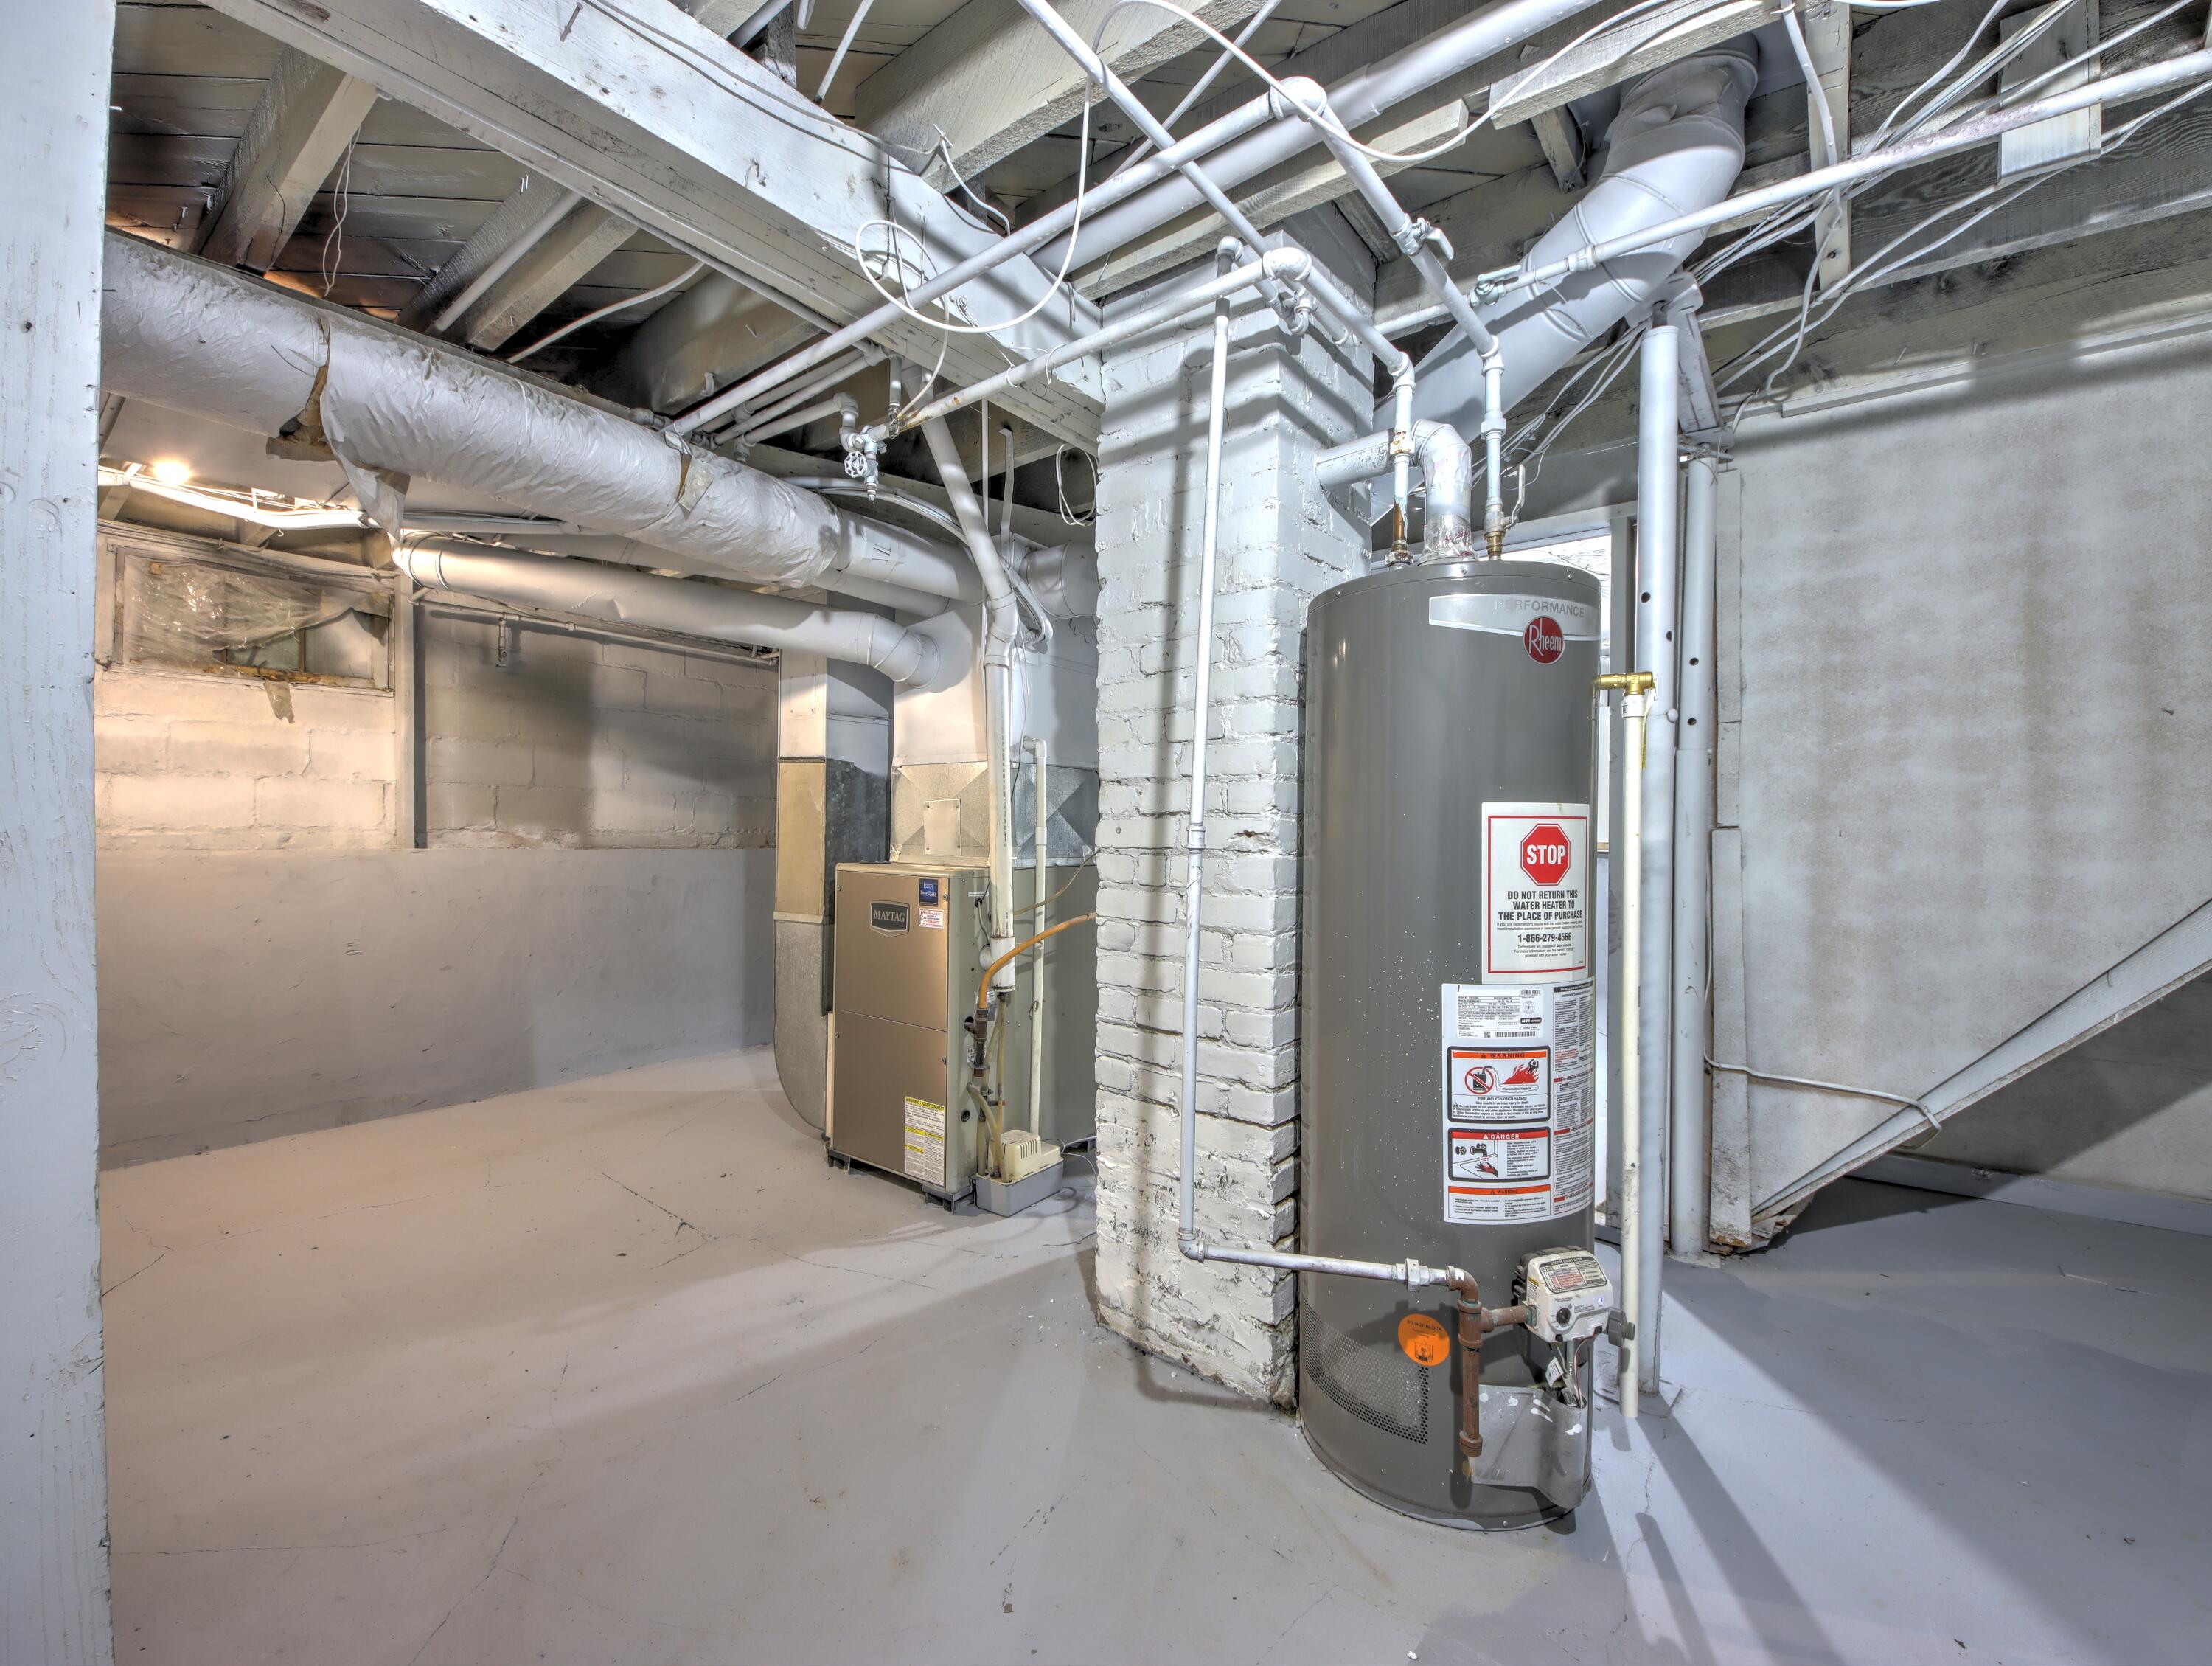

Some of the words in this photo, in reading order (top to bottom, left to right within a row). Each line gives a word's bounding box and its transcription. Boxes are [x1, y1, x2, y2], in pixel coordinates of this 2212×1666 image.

[1495, 599, 1585, 618] PERFORMANCE
[1528, 617, 1562, 656] Rheem
[1526, 844, 1566, 865] STOP
[1507, 891, 1519, 900] DO
[1521, 891, 1537, 900] NOT
[1539, 890, 1565, 899] RETURN
[1566, 889, 1578, 898] THIS
[1513, 901, 1540, 910] WATER
[1542, 900, 1567, 909] HEATER
[1568, 900, 1575, 909] TO
[873, 909, 905, 923] MAYTAG
[1498, 912, 1514, 920] THE
[1517, 912, 1542, 920] PLACE
[1543, 912, 1553, 920] OF
[1554, 910, 1582, 920] PURCHASE
[1517, 932, 1572, 943] 1-866-279-4566
